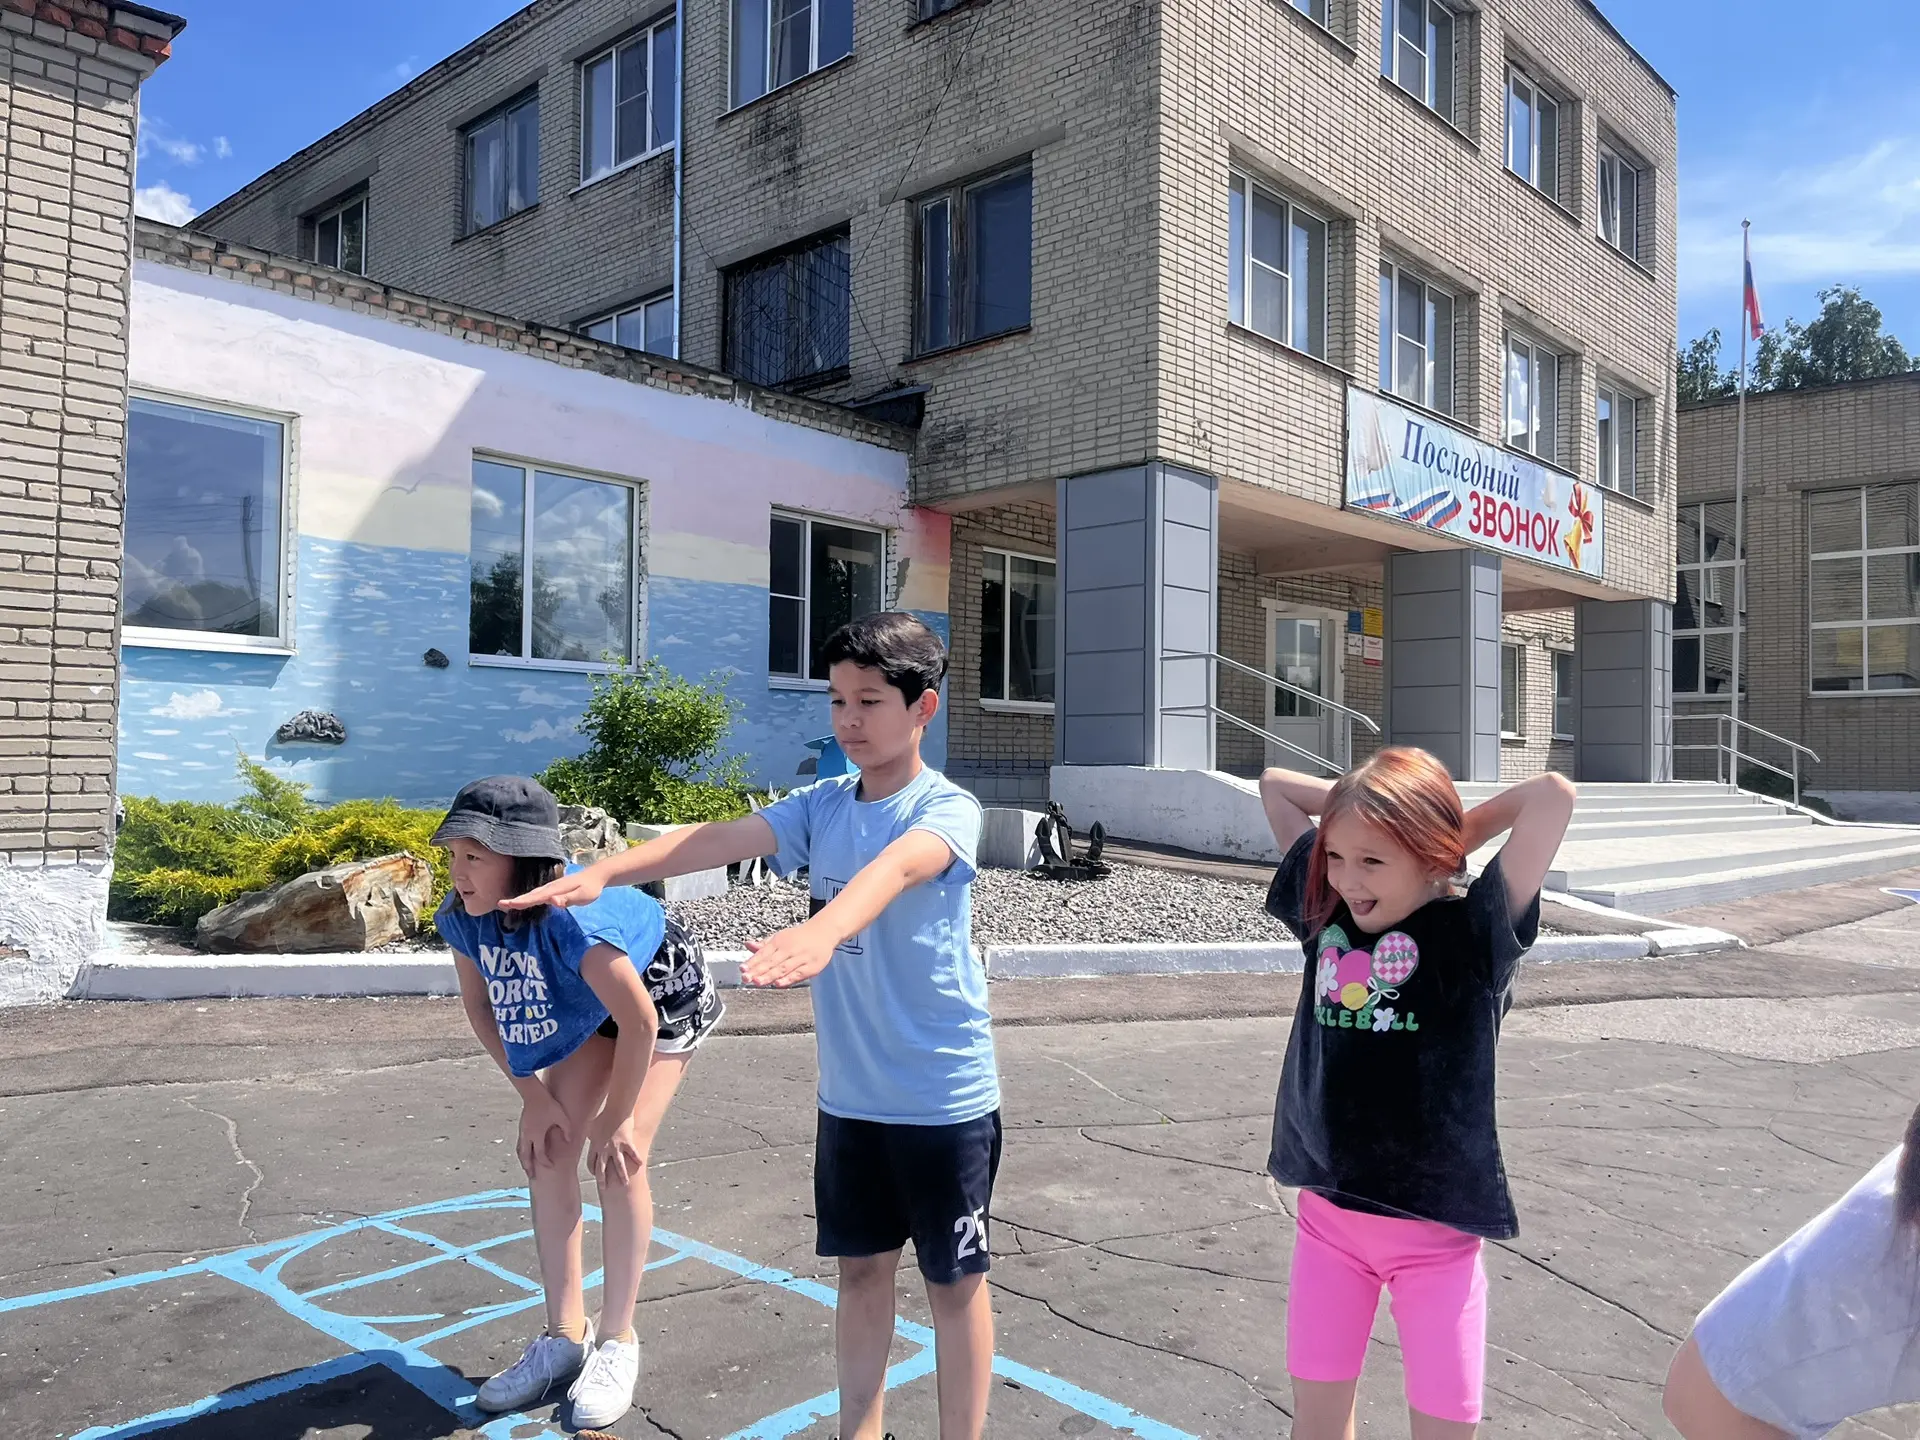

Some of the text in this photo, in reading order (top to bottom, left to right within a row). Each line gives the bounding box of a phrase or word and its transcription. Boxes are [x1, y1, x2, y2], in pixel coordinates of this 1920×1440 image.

[1401, 419, 1520, 501] Последний
[1468, 490, 1561, 557] ЗВОНОК
[492, 1005, 522, 1021] HY
[954, 1204, 988, 1260] 25
